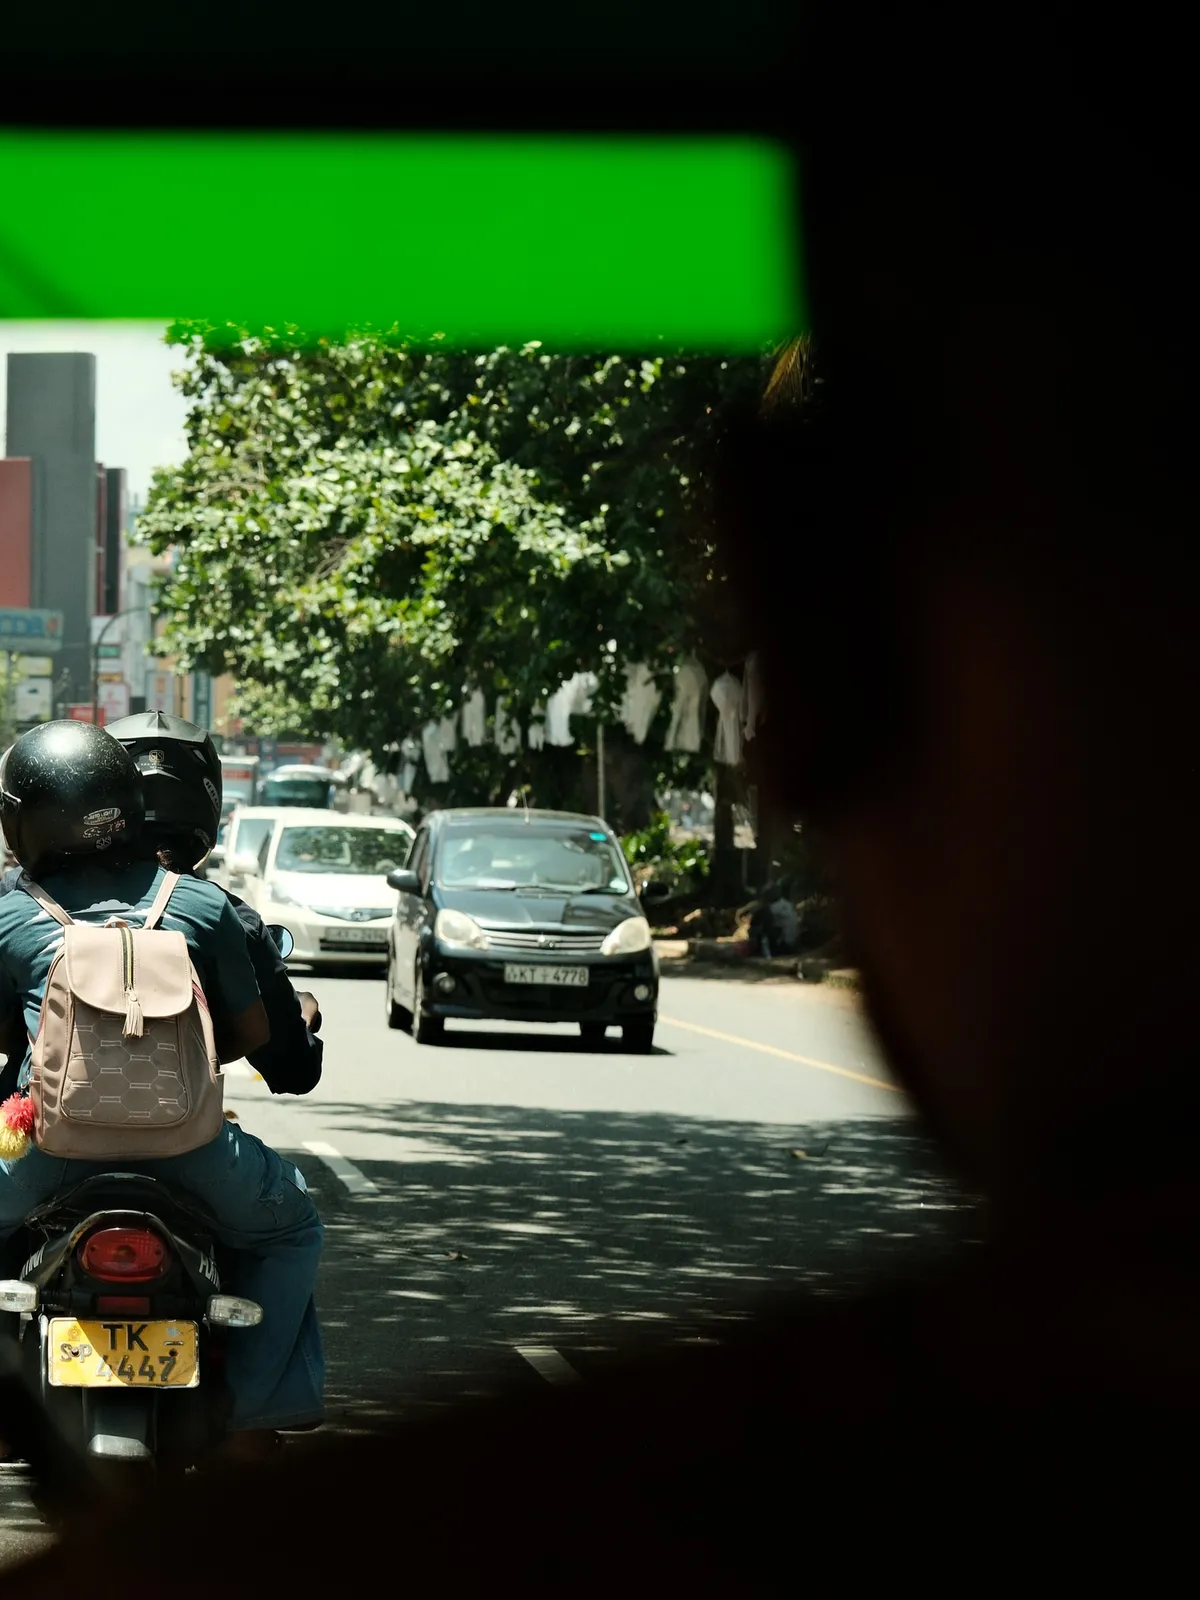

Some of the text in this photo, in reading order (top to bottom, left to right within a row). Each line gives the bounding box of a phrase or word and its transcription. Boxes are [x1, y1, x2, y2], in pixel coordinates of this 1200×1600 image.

[102, 1323, 149, 1352] TK
[59, 1342, 93, 1363] SP
[95, 1355, 178, 1382] 4447
